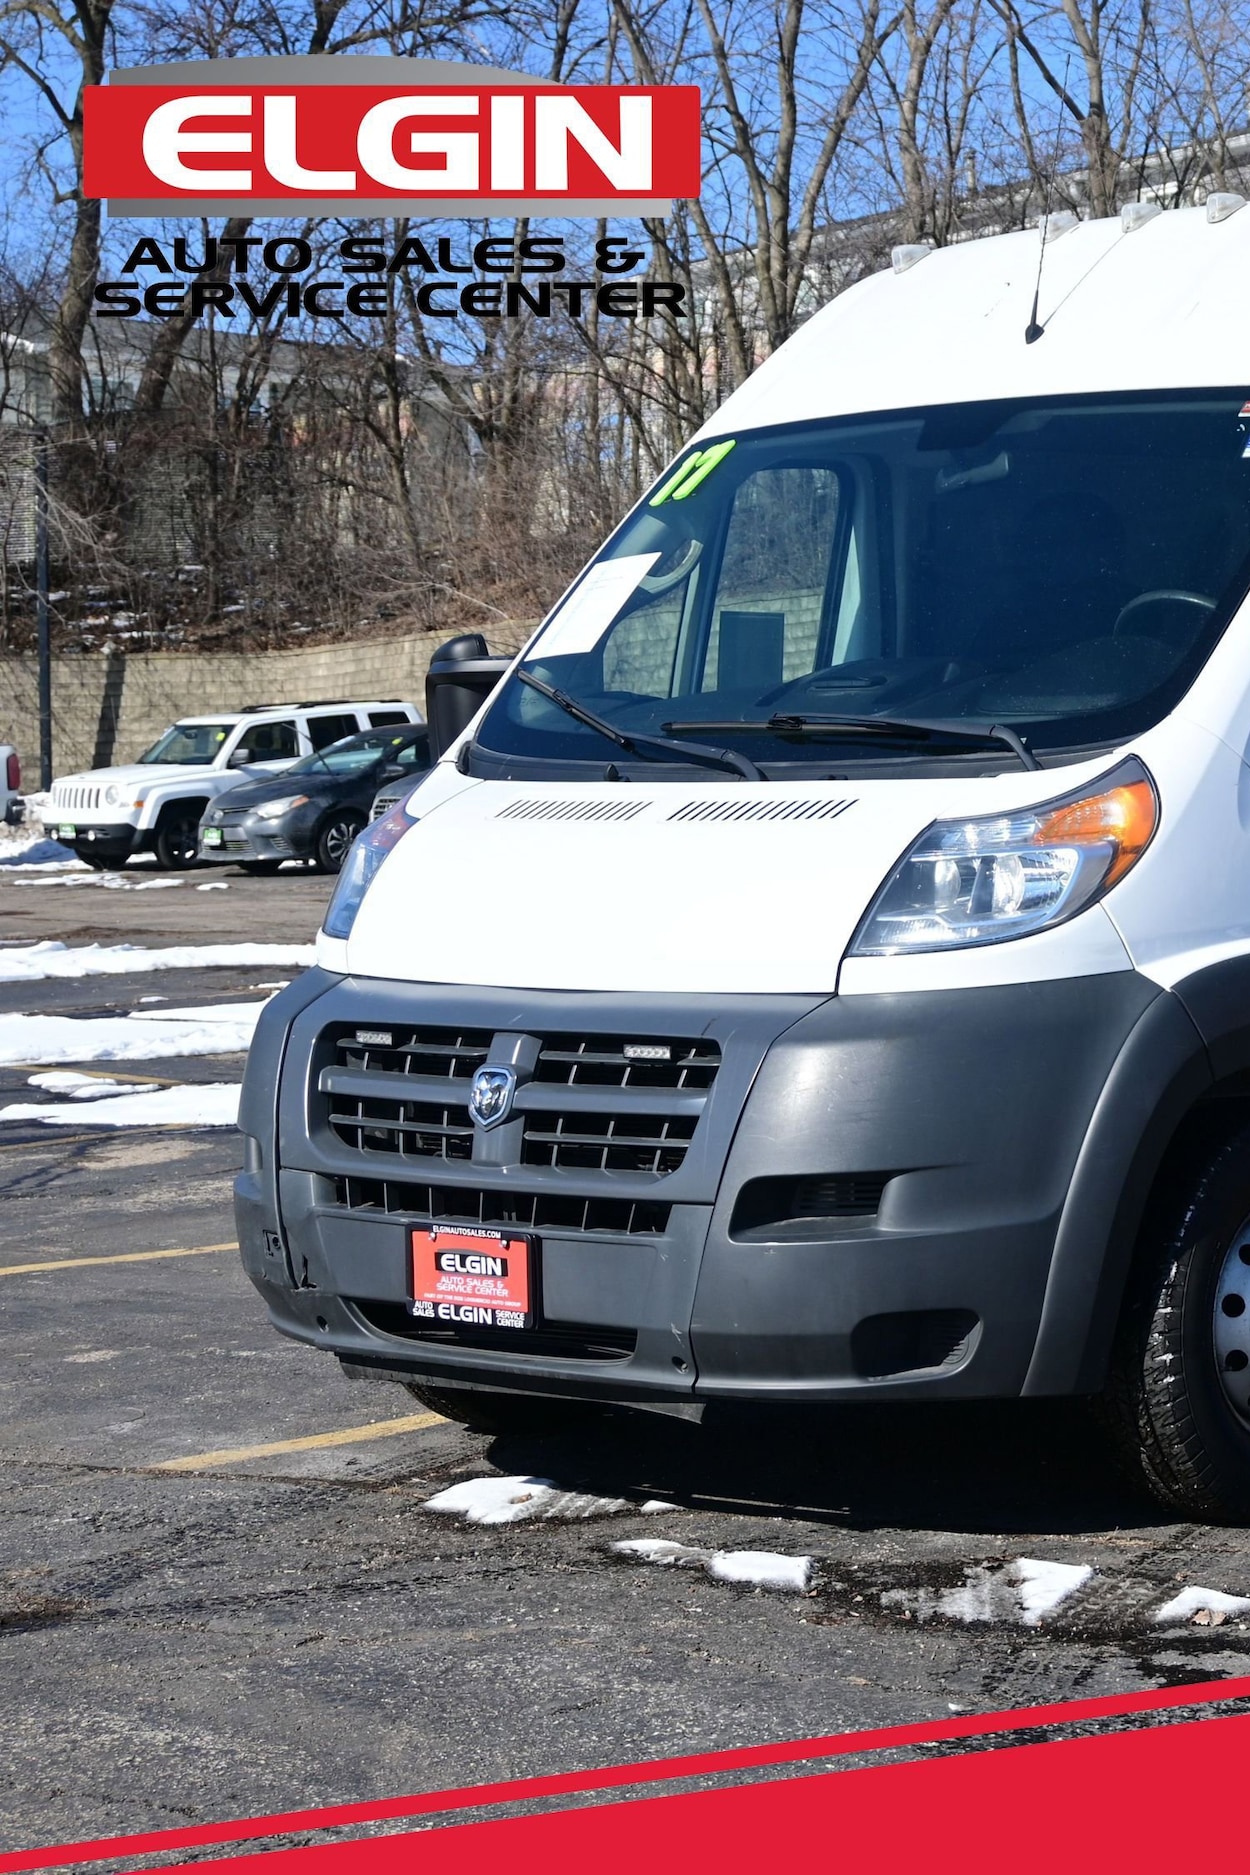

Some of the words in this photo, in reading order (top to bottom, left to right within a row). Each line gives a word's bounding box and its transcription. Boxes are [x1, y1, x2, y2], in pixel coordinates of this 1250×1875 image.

[649, 439, 736, 507] 17
[432, 1225, 501, 1239] ELGINAUTOSALES.COM
[440, 1253, 502, 1276] ELGIN
[440, 1276, 464, 1285] AUTO
[465, 1278, 495, 1288] SALES
[497, 1281, 504, 1289] &
[436, 1282, 473, 1294] SERVICE
[474, 1286, 509, 1297] CENTER
[414, 1300, 433, 1310] AUTO
[412, 1307, 435, 1318] SALES
[438, 1303, 493, 1325] ELGIN
[495, 1310, 525, 1321] SERVICE
[496, 1318, 525, 1329] CENTER
